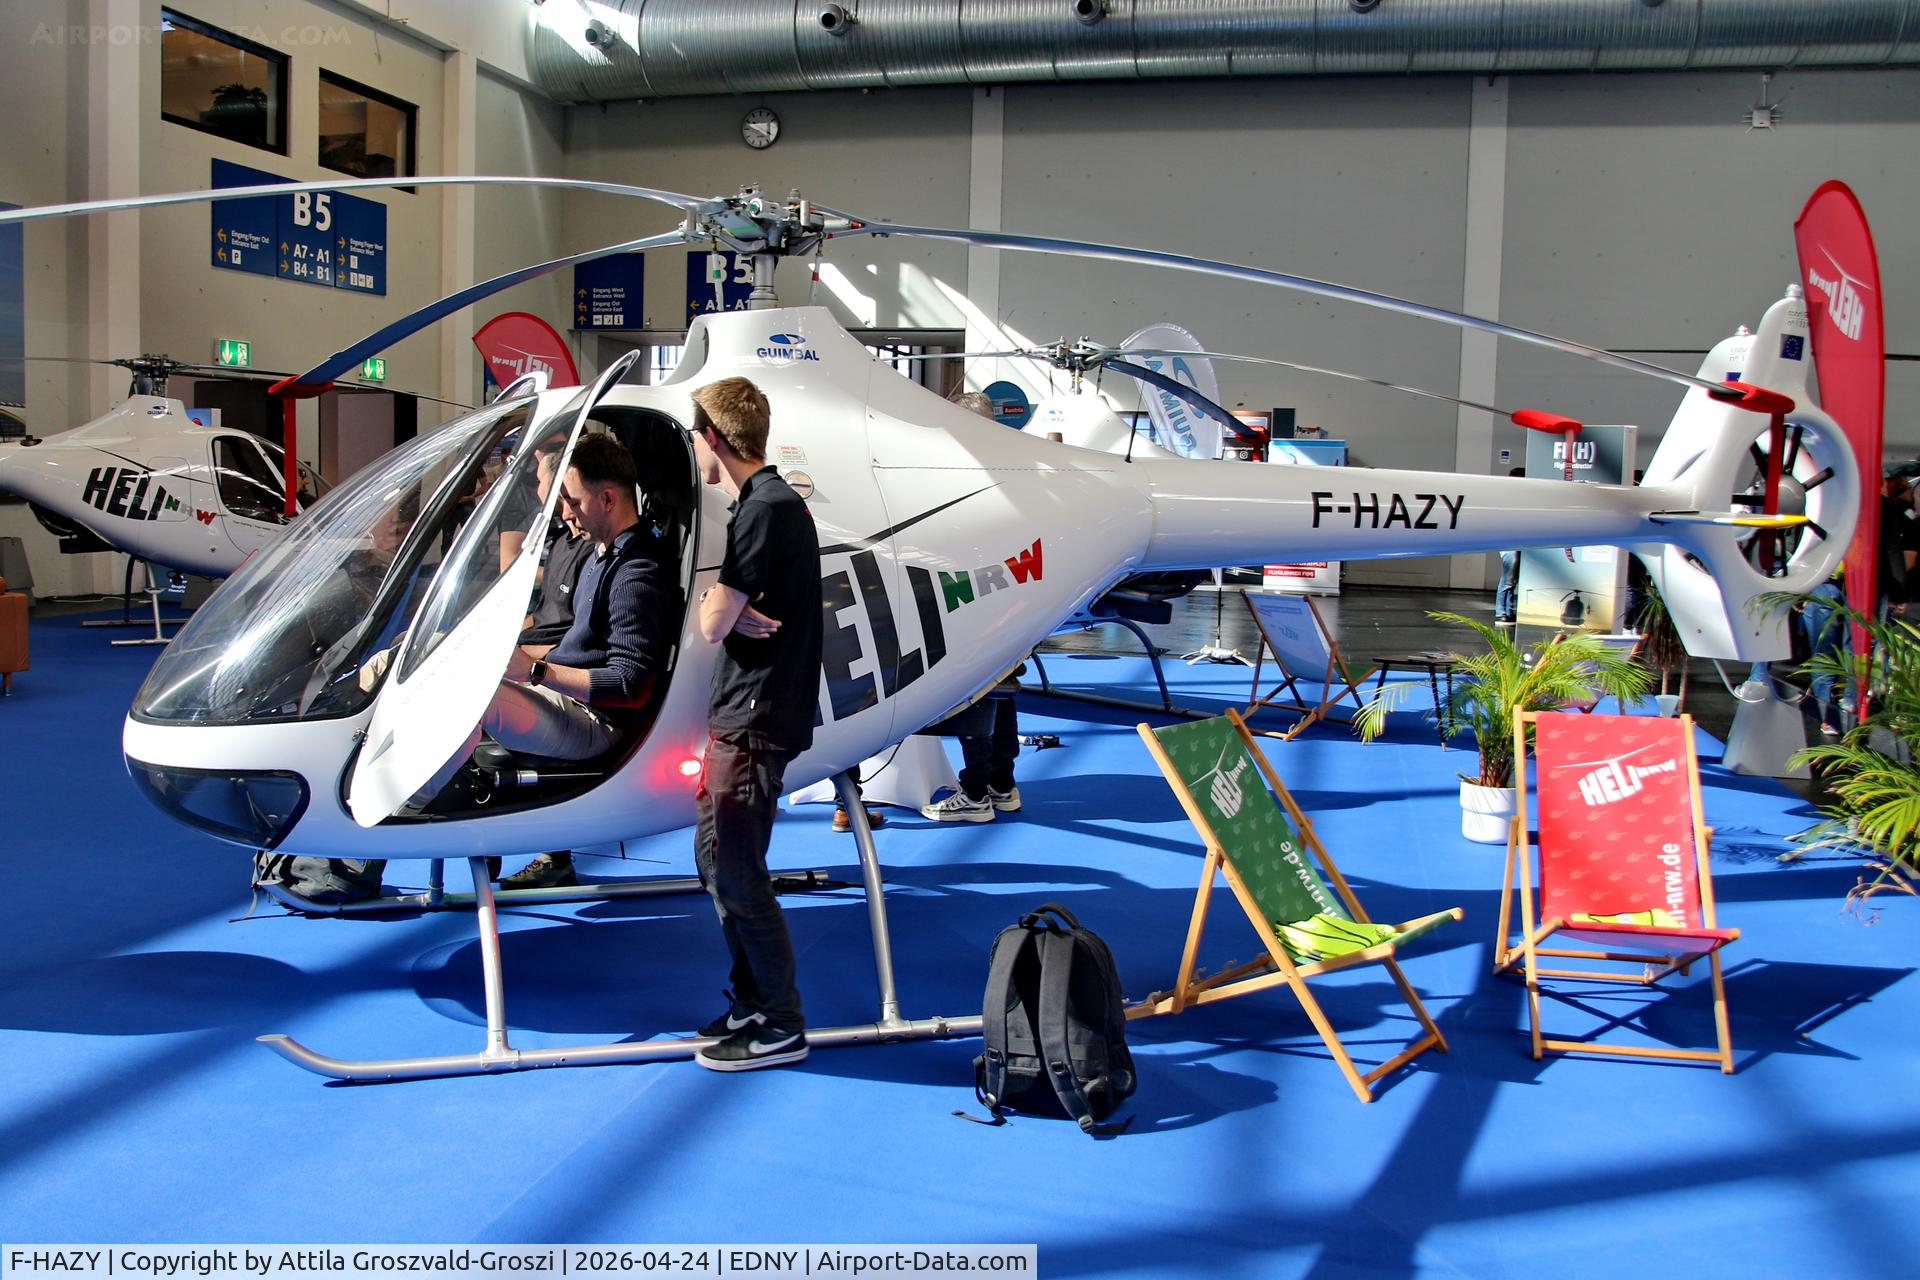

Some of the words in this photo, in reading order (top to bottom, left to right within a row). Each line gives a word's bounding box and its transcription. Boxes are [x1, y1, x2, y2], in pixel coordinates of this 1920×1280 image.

[293, 191, 331, 232] B5
[293, 243, 309, 259] A7
[316, 249, 330, 264] A1
[293, 261, 308, 277] B4
[316, 266, 330, 281] B1
[706, 254, 754, 284] B5
[756, 347, 820, 361] GUIMBAL
[82, 467, 167, 521] HELI
[165, 494, 217, 526] NRW
[1311, 491, 1465, 530] F-HAZY
[812, 549, 947, 727] ELI
[937, 537, 1043, 614] NRW
[1210, 767, 1242, 819] HELI
[1577, 759, 1643, 806] HELI
[1636, 758, 1678, 778] NRW
